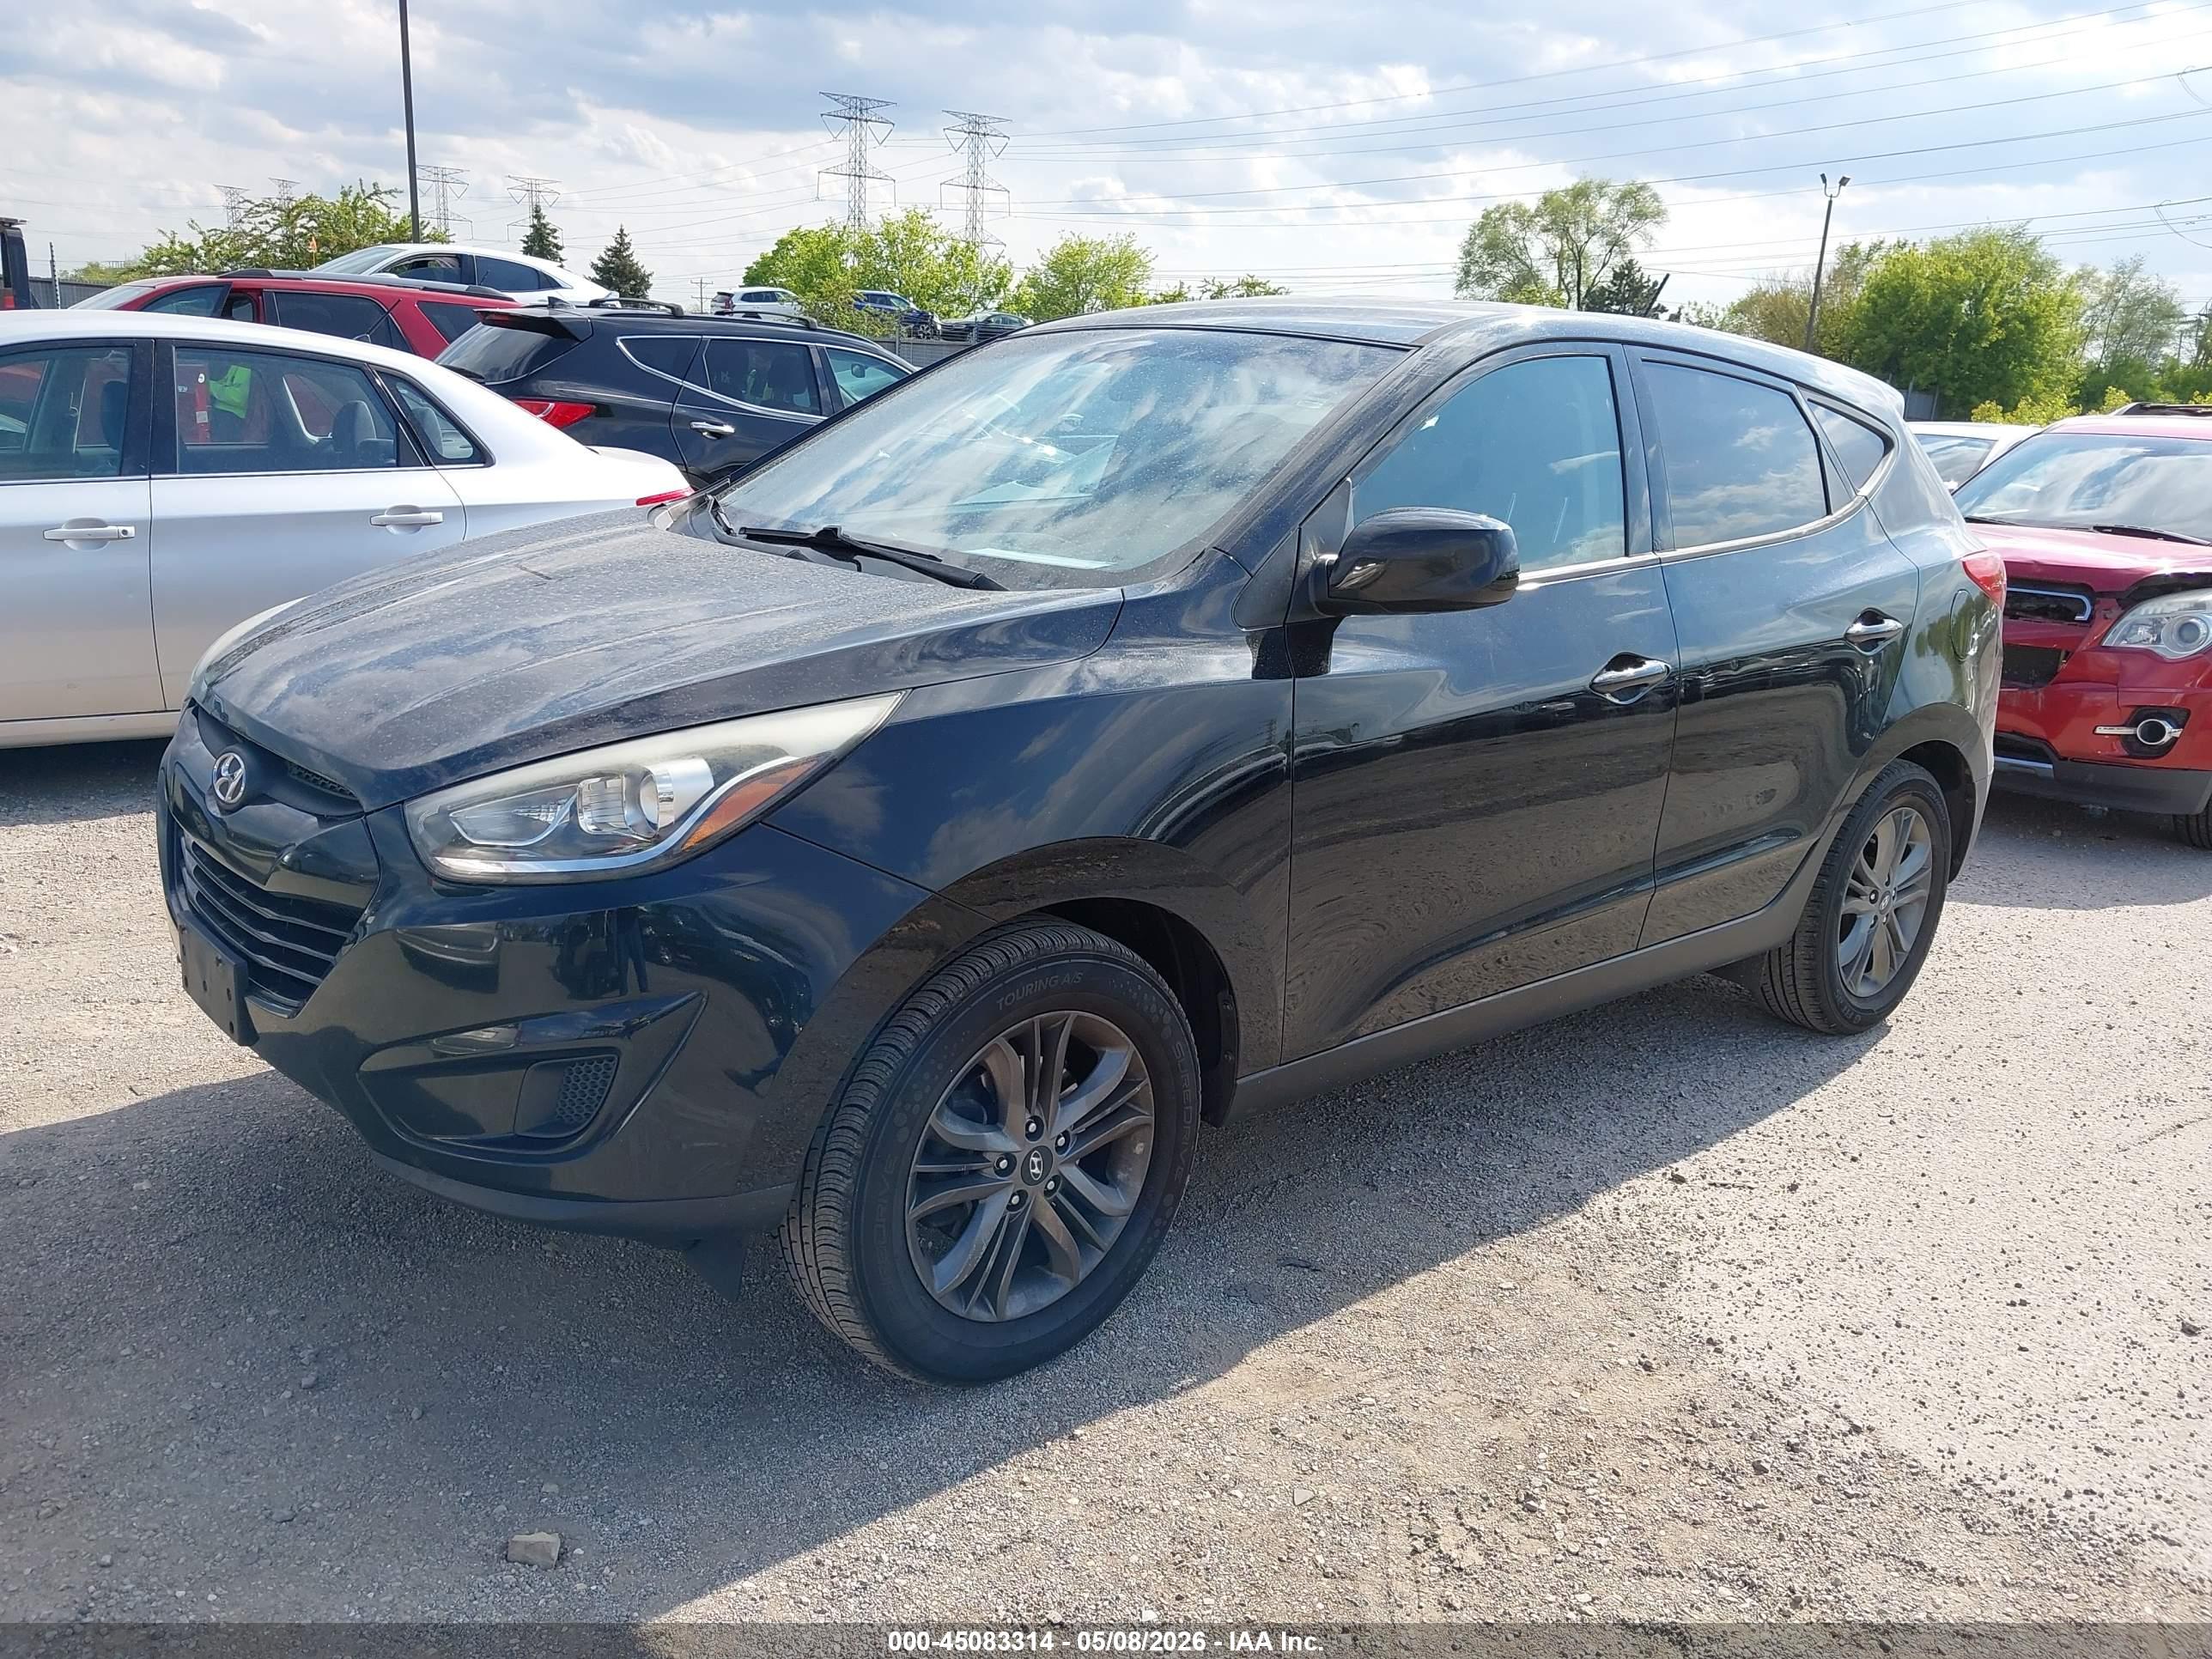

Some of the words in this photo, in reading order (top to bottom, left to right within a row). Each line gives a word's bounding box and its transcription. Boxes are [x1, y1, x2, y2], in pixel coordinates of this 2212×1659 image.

[996, 975, 1060, 1011] TOURING
[1060, 971, 1084, 985] A/S
[1170, 1041, 1194, 1182] SUREDRIVE
